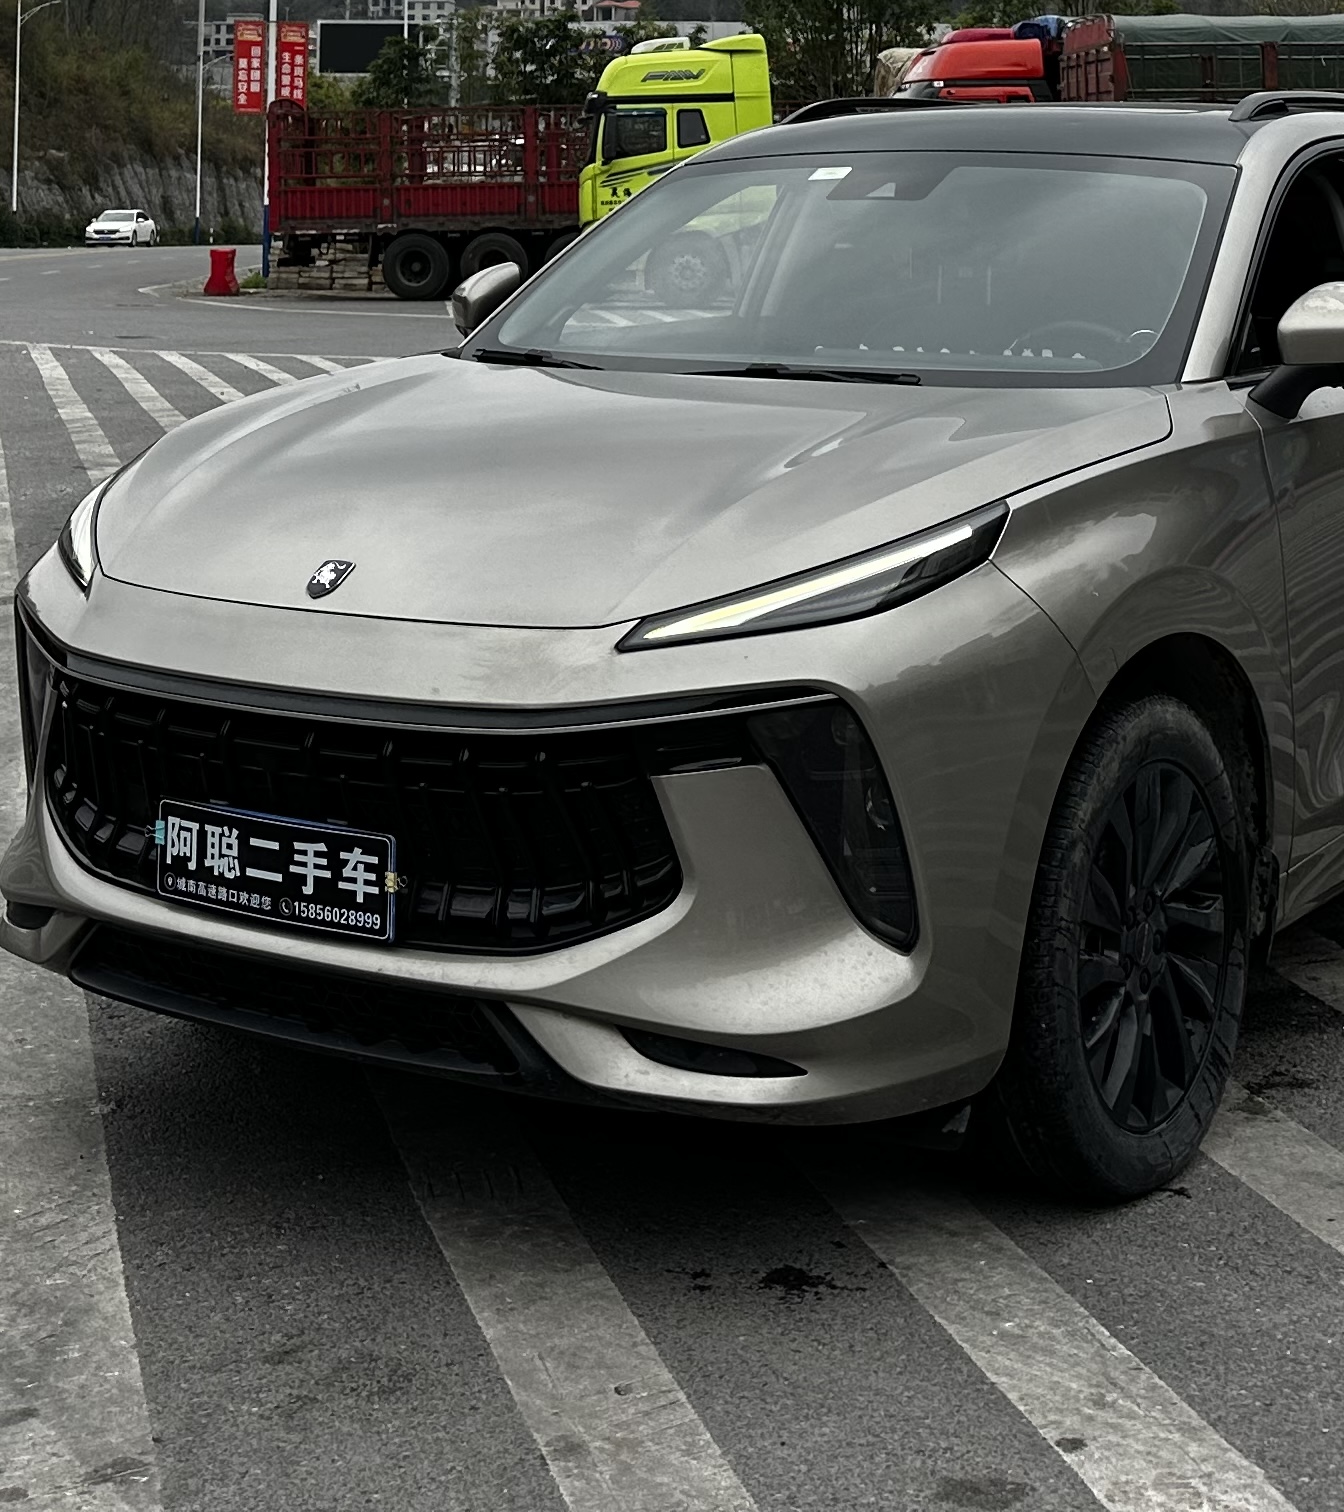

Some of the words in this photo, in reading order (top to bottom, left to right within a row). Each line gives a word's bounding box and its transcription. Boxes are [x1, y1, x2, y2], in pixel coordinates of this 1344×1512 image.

[166, 816, 379, 903] 阿聪二手车
[177, 877, 272, 910] 城南高速路口欢迎您
[293, 901, 381, 930] 15856028999
